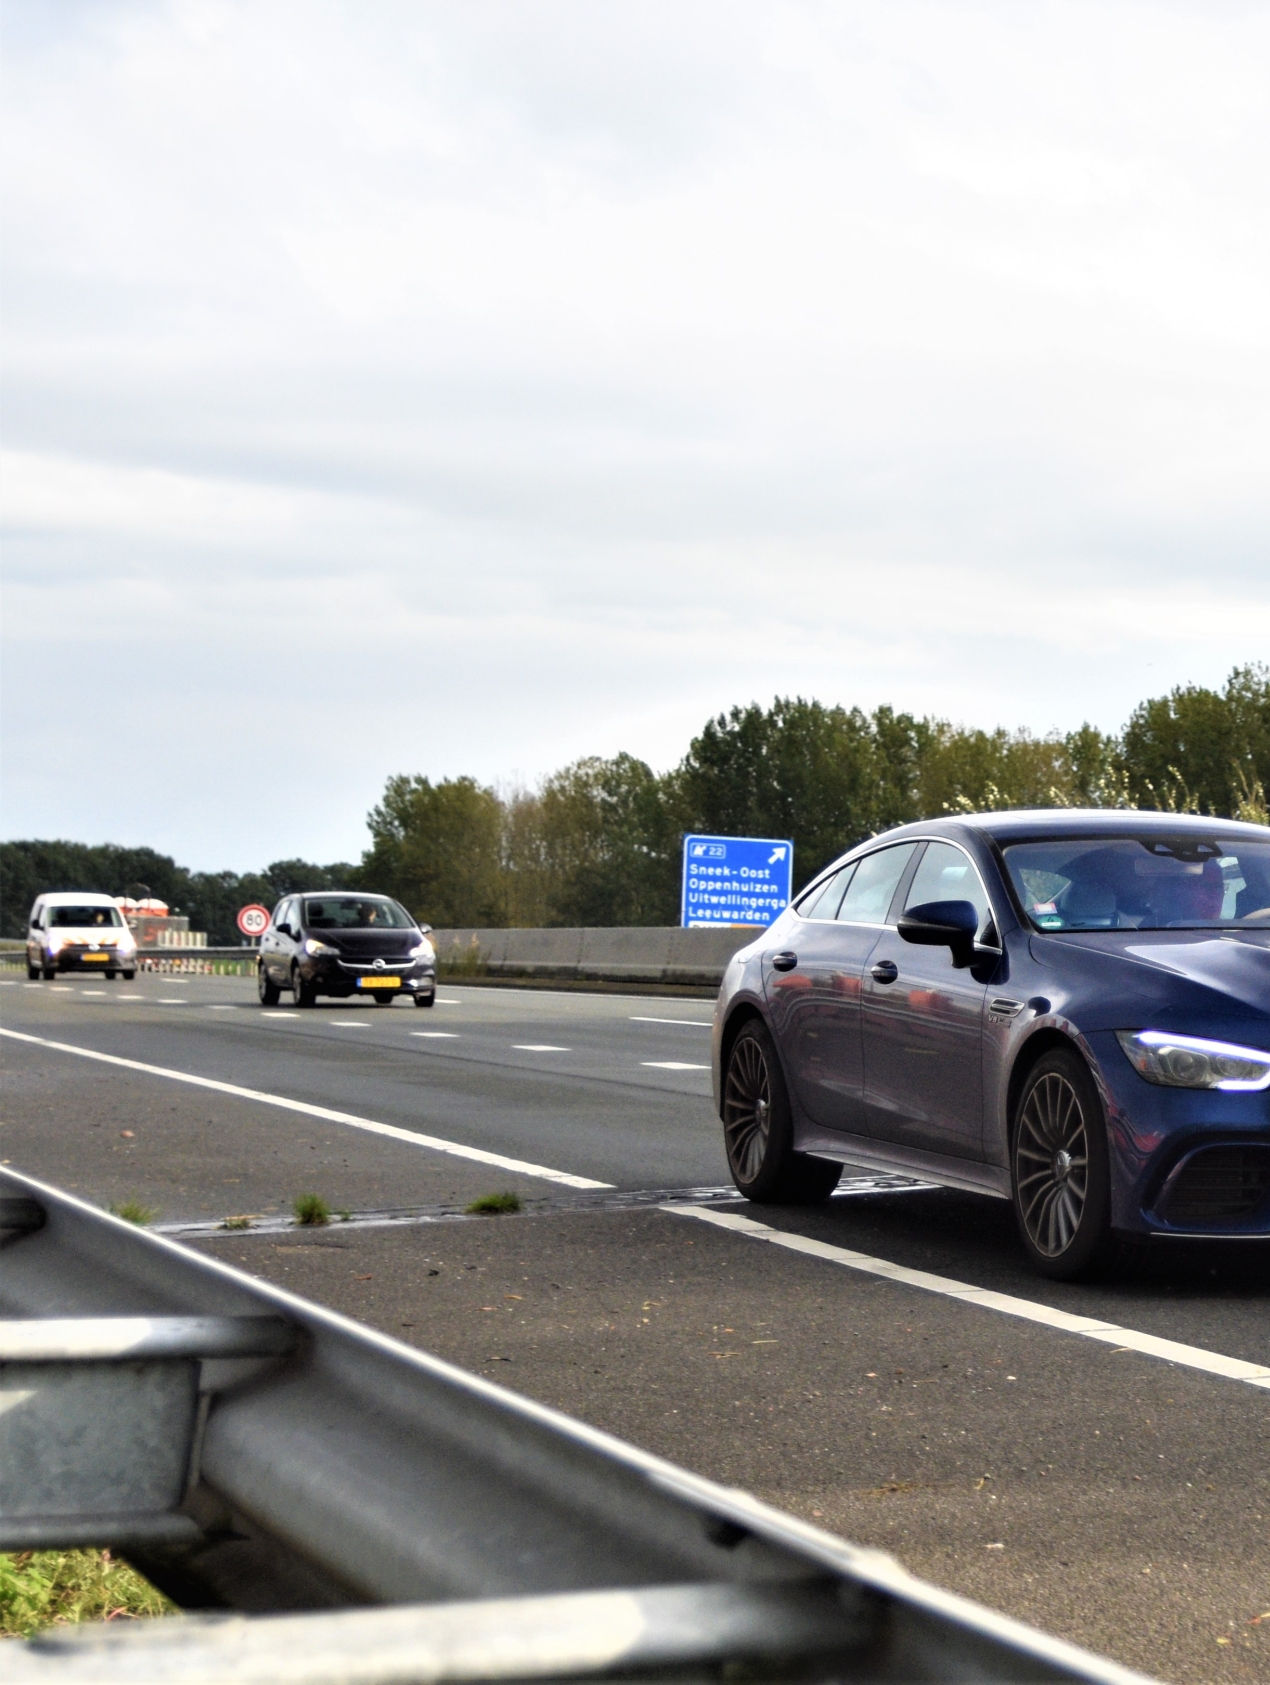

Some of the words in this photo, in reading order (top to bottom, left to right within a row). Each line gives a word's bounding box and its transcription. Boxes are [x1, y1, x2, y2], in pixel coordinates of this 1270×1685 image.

[708, 847, 723, 856] 22
[689, 878, 778, 893] Oppenhuizen
[688, 892, 787, 910] Uitwellingerga
[246, 914, 263, 926] 80
[688, 906, 770, 921] Leeuwarden
